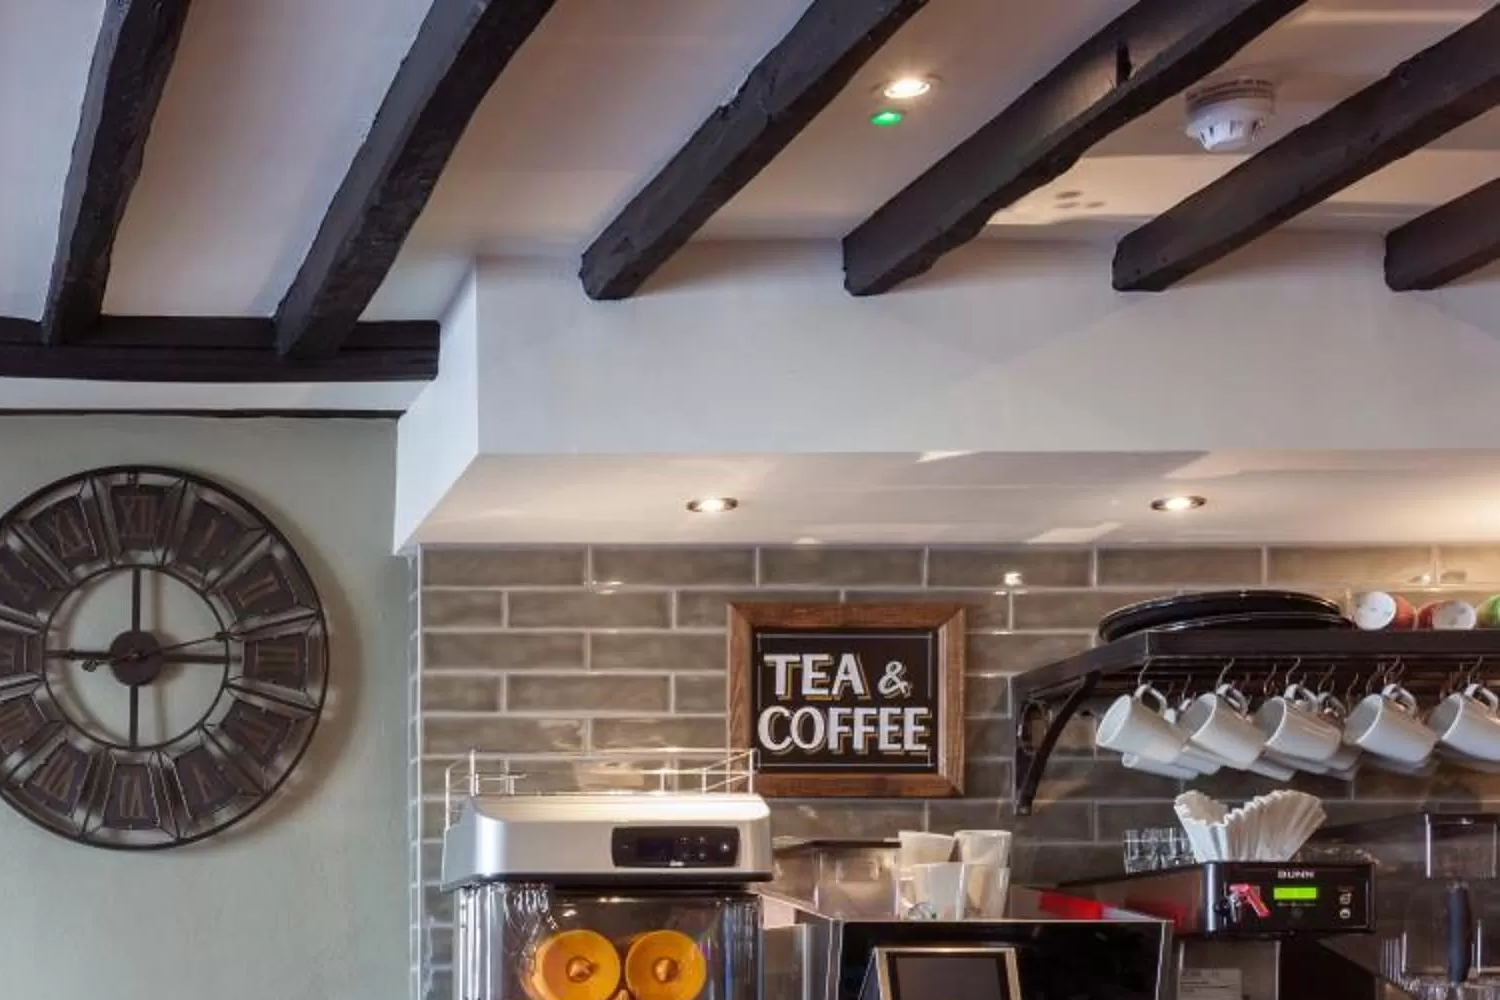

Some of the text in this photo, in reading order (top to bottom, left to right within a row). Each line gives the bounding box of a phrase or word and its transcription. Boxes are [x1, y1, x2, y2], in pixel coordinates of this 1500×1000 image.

[763, 653, 912, 700] TEA &
[757, 706, 932, 755] COFFEE
